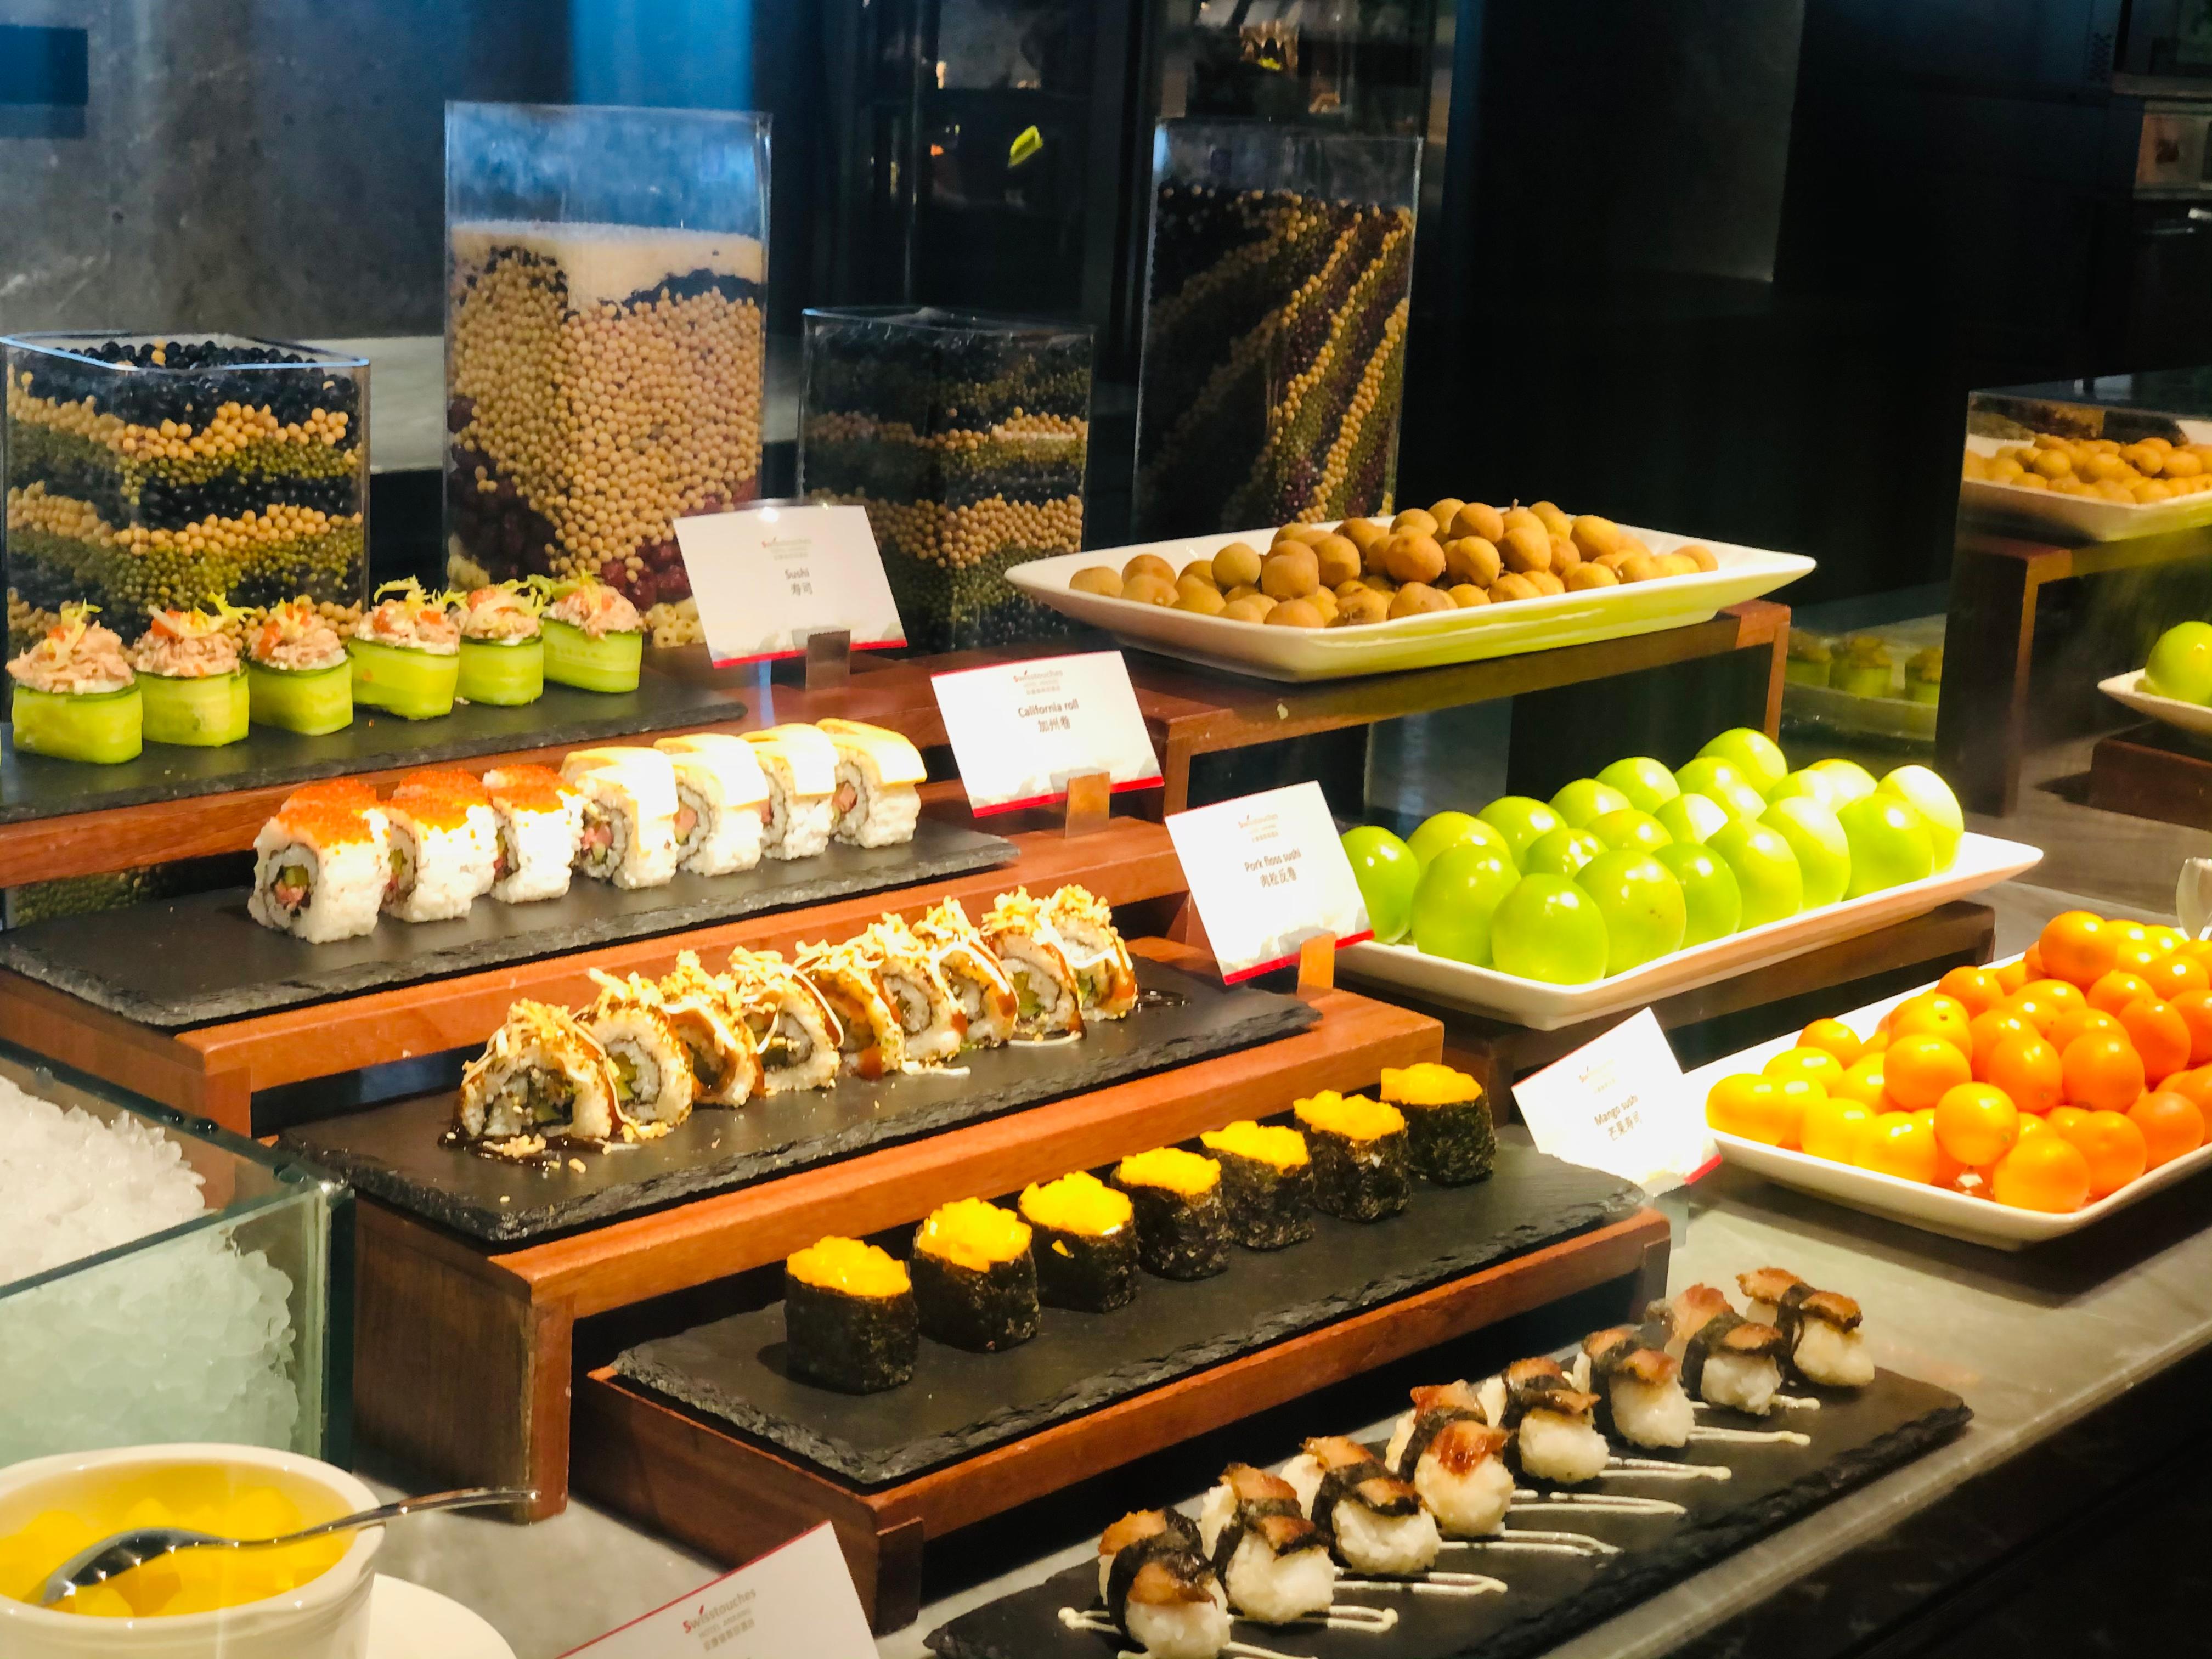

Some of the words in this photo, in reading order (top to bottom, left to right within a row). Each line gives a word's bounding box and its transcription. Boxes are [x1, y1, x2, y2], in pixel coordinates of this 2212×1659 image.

[785, 567, 810, 580] Sushi
[791, 582, 813, 596] 寿司
[1018, 702, 1062, 718] California
[1064, 698, 1079, 711] roll
[1038, 715, 1070, 733] 加州卷
[1244, 859, 1263, 872] Pork
[1263, 855, 1282, 867] floss
[1283, 848, 1302, 862] sushi
[1594, 1106, 1621, 1126] Mango
[1621, 1094, 1639, 1111] sushi
[1607, 1111, 1642, 1141] 芒果寿司
[682, 1588, 756, 1634] Swisstouches
